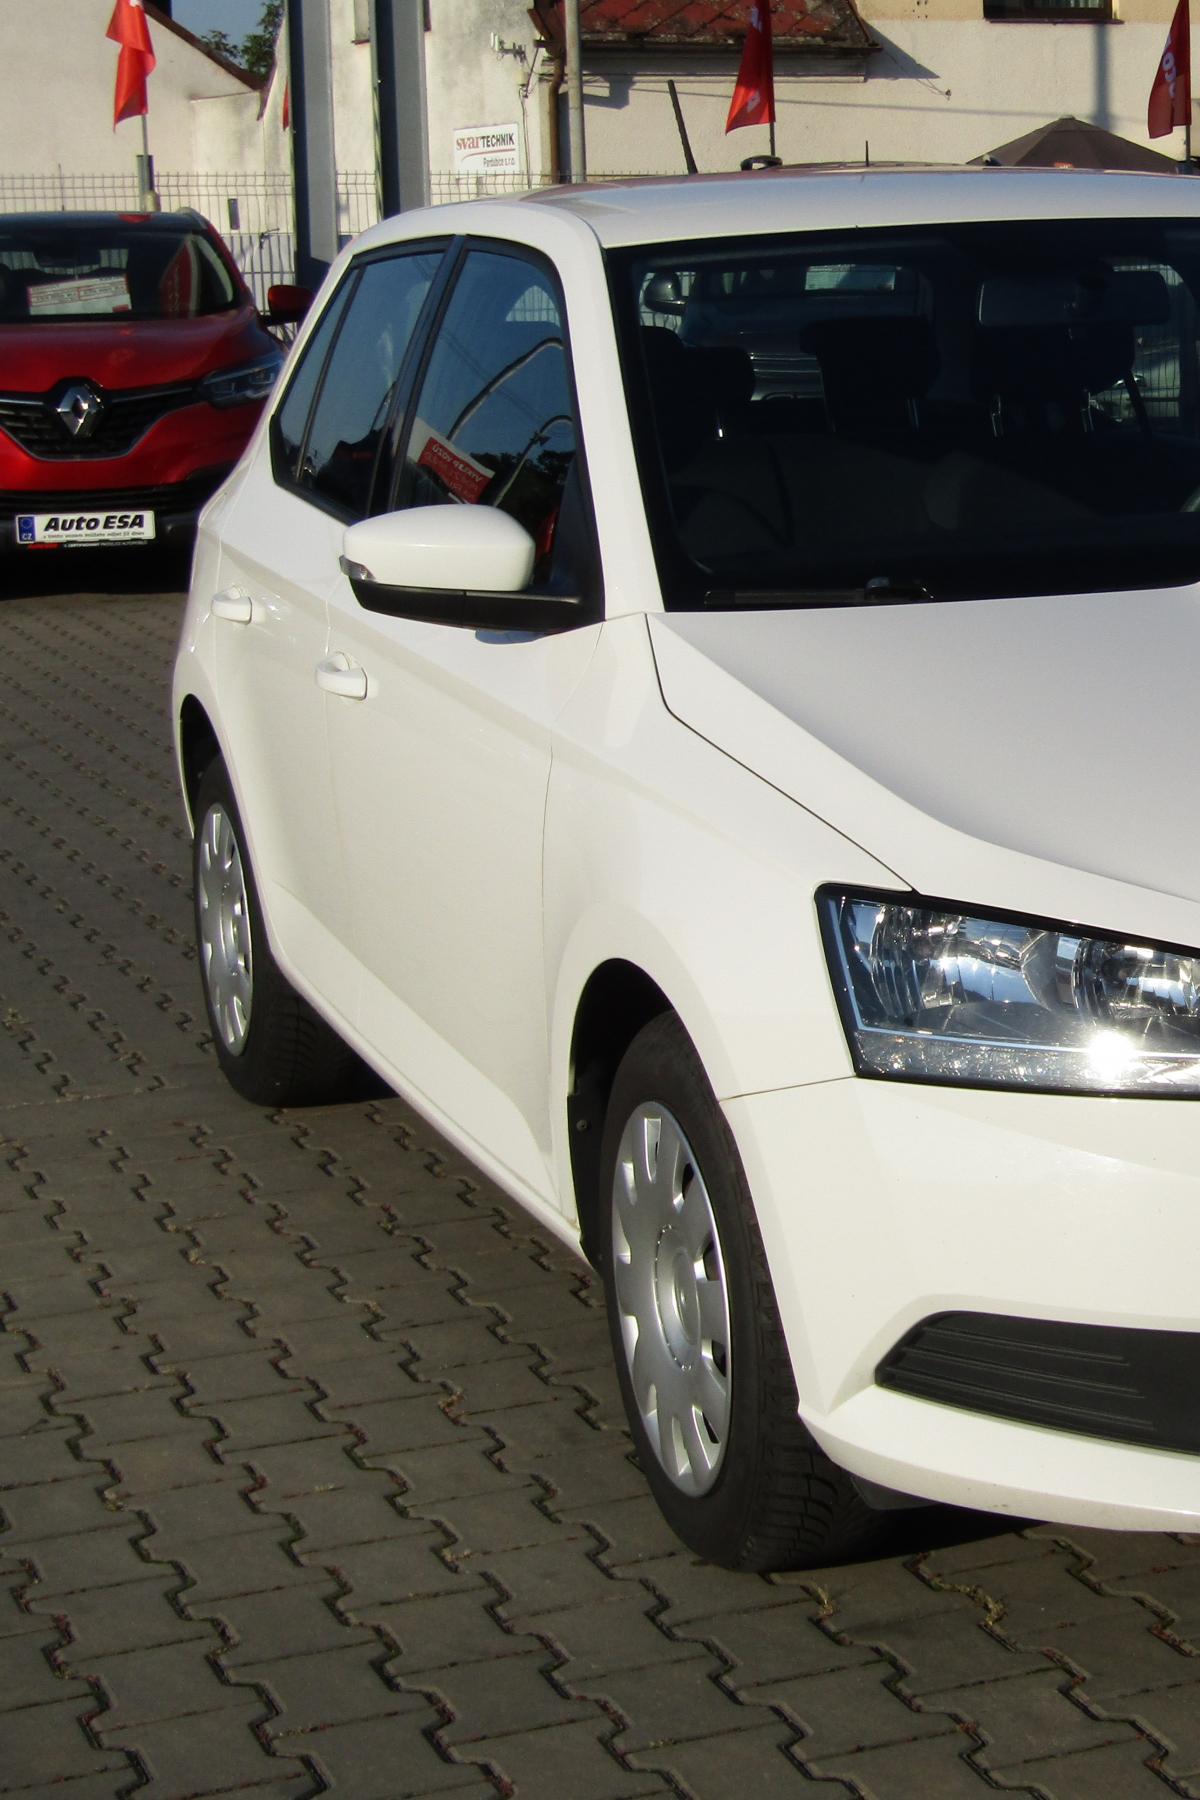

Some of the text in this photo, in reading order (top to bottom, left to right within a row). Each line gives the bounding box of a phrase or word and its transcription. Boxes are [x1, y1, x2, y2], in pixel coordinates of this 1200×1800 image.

[456, 133, 515, 150] svarTECHNIK
[44, 514, 145, 531] Auto ESA
